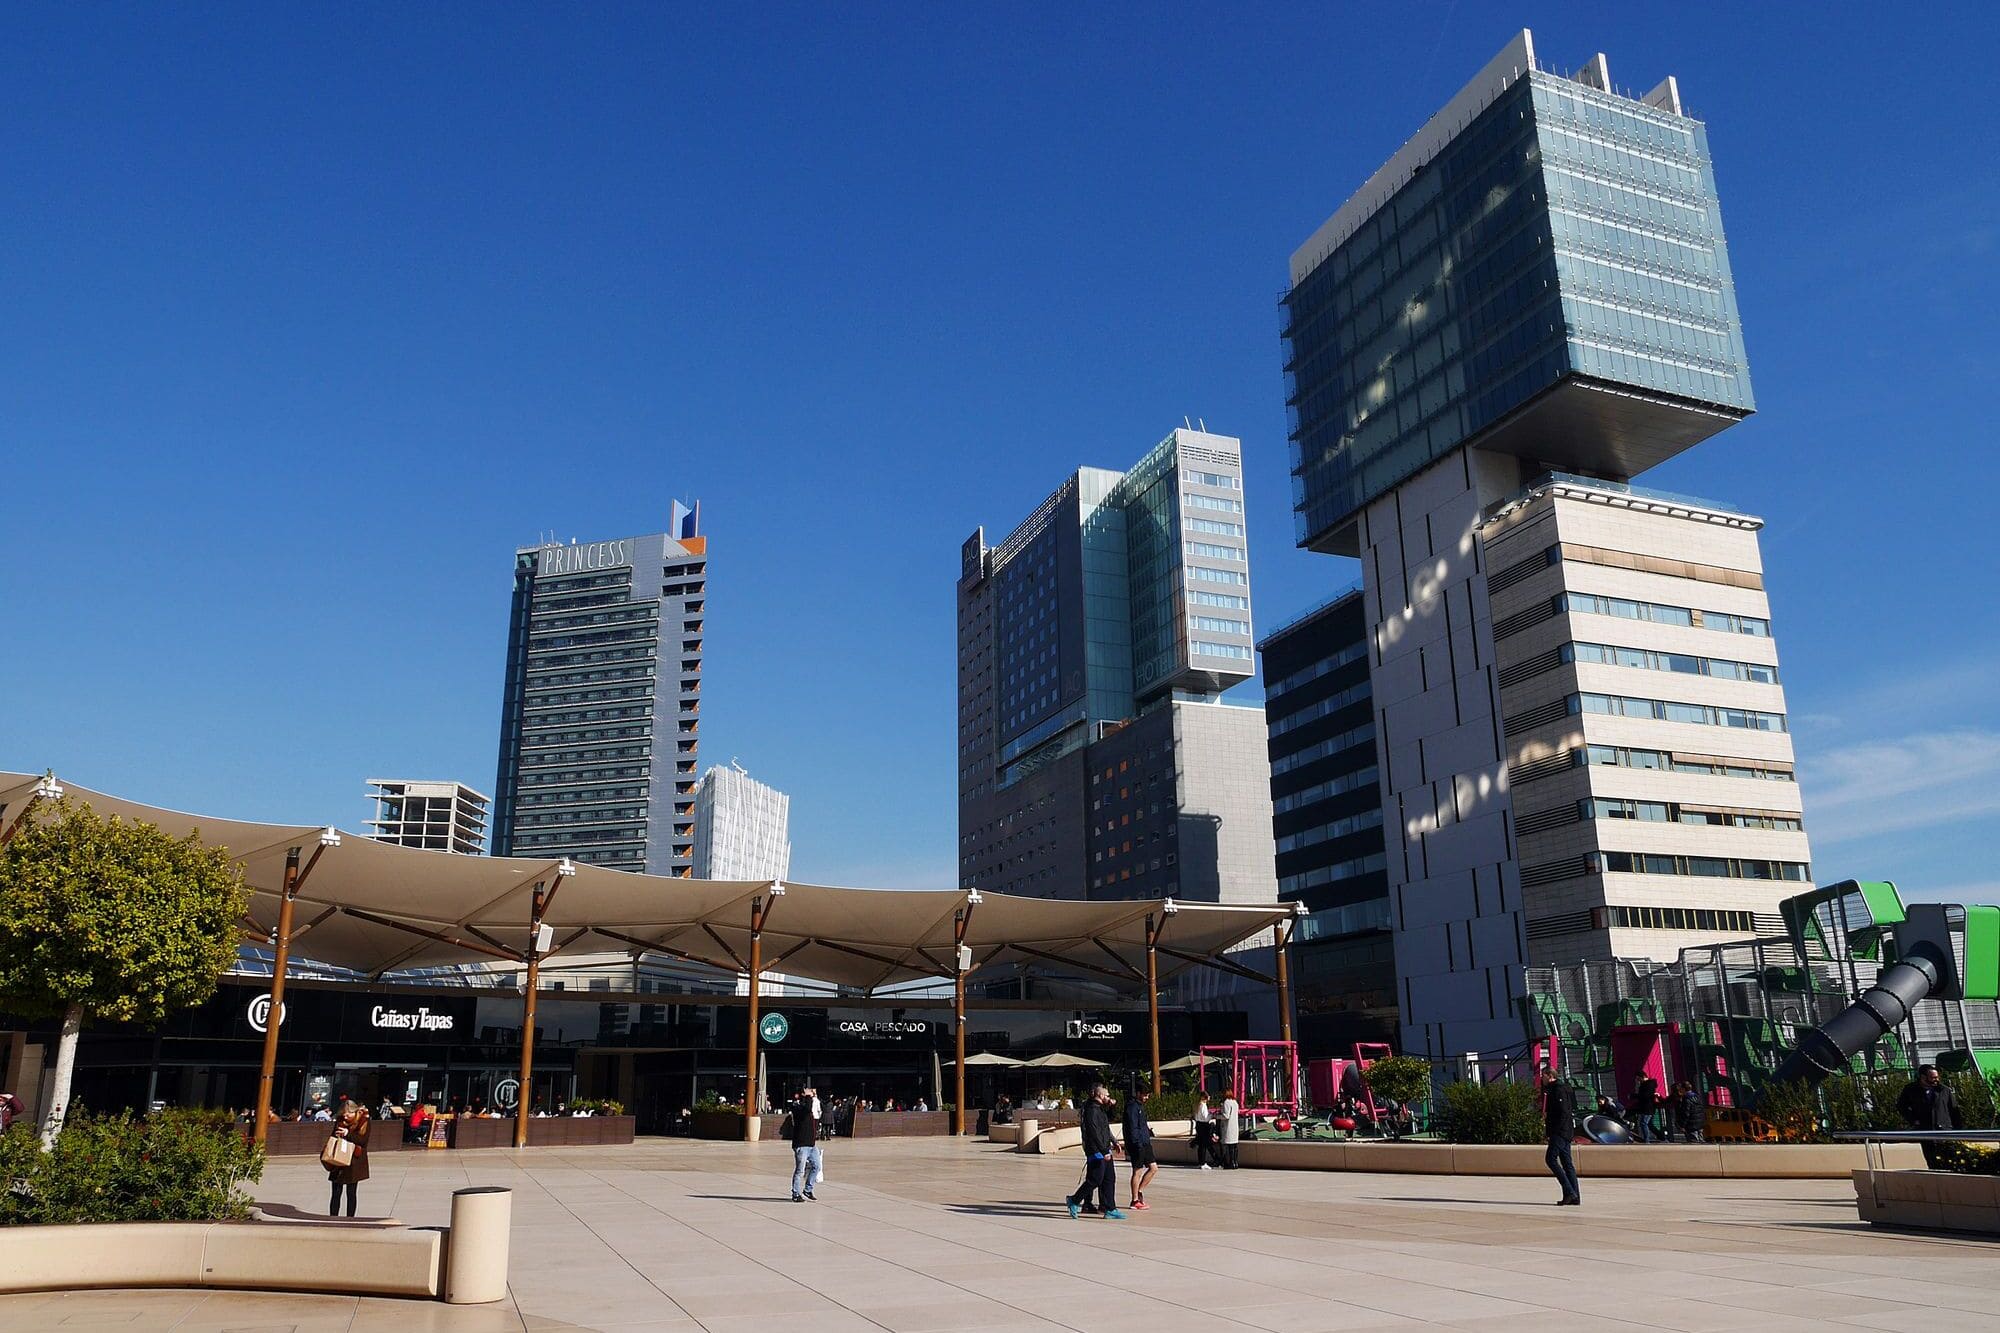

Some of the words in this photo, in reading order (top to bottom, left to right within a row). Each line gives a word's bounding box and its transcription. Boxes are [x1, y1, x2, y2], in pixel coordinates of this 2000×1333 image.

[545, 541, 625, 574] PRINCESS
[371, 1005, 411, 1028] Cañas
[410, 1014, 420, 1031] y
[418, 1007, 453, 1031] Tapas
[840, 1021, 869, 1032] CASA
[874, 1021, 926, 1032] PESCADO
[1082, 1023, 1122, 1034] SAGARDI
